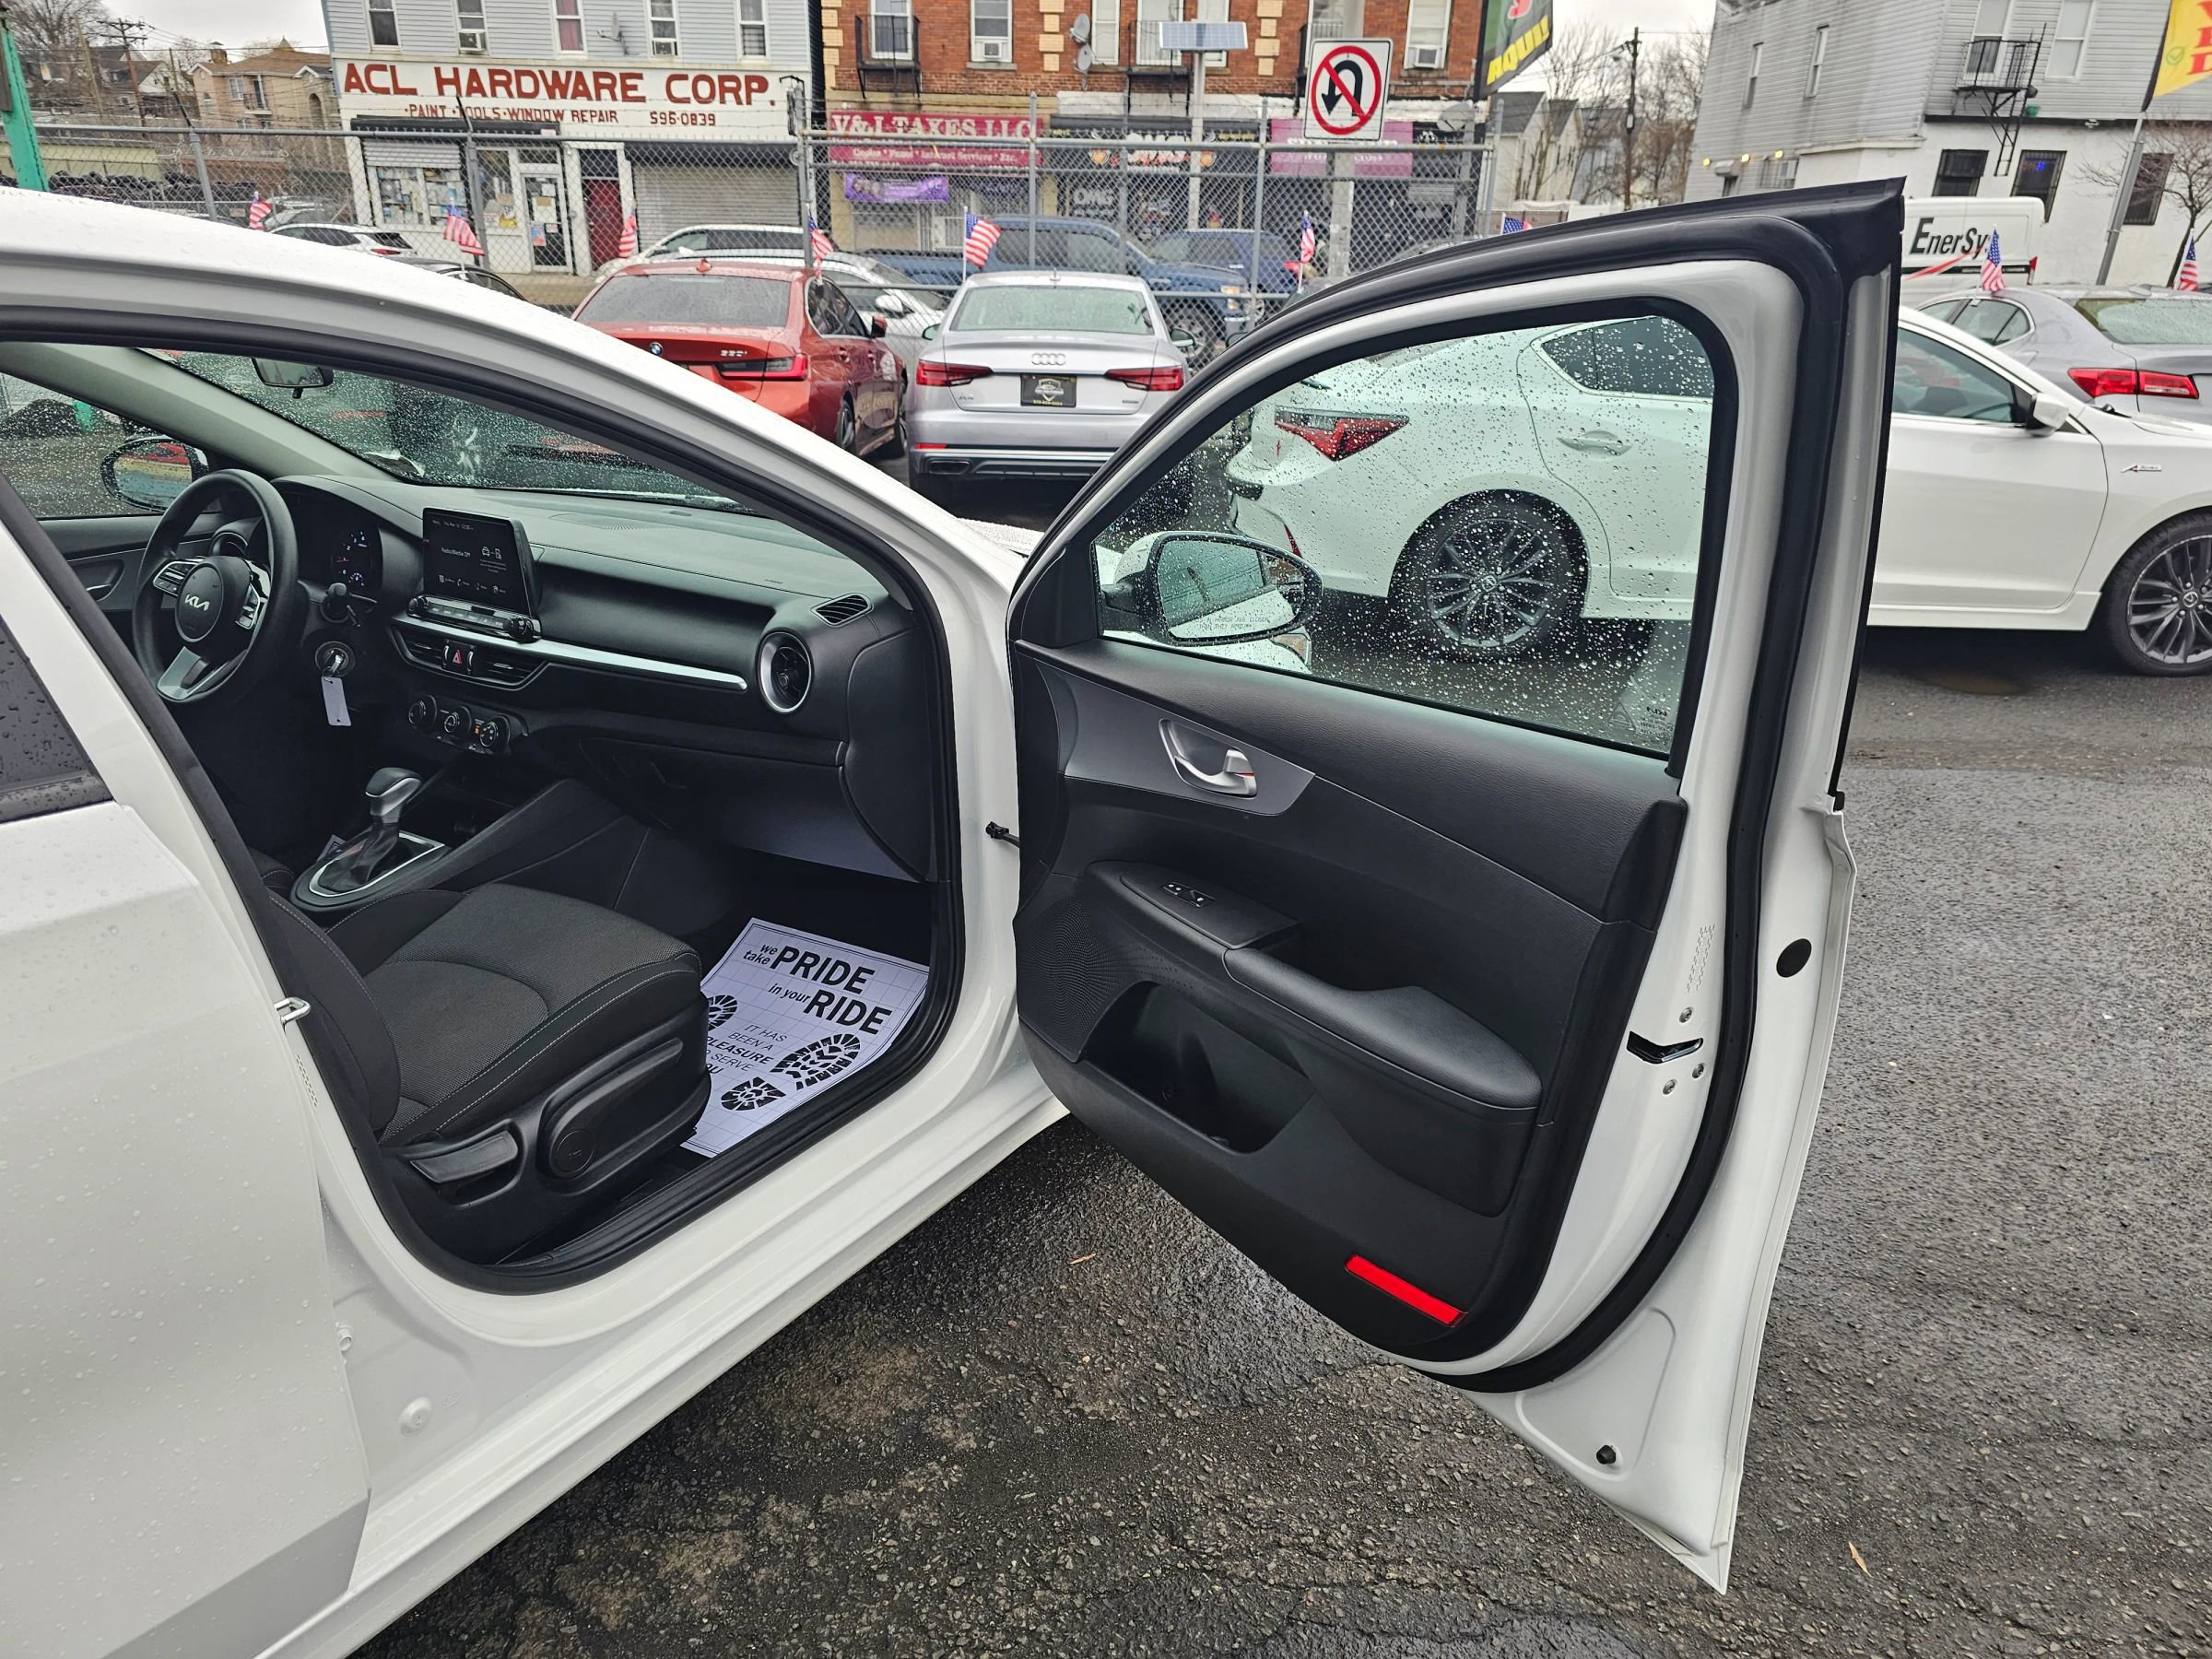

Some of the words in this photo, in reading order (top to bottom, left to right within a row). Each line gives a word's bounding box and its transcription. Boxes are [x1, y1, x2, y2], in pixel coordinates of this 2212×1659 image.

[344, 63, 418, 95] ACL
[433, 66, 646, 103] HARDWARE
[665, 73, 775, 106] CORP.
[571, 109, 618, 124] REPAIR
[892, 116, 977, 136] TAXES
[1909, 217, 1991, 260] EnerSy
[743, 950, 771, 966] take
[759, 944, 778, 955] we
[770, 946, 875, 994] PRIDE
[768, 982, 781, 994] in
[780, 988, 811, 1004] your
[804, 989, 892, 1035] RIDE
[728, 1031, 764, 1047] BEEN
[744, 1024, 761, 1032] IT
[759, 1029, 787, 1042] HAS
[711, 1053, 754, 1072] SERVE
